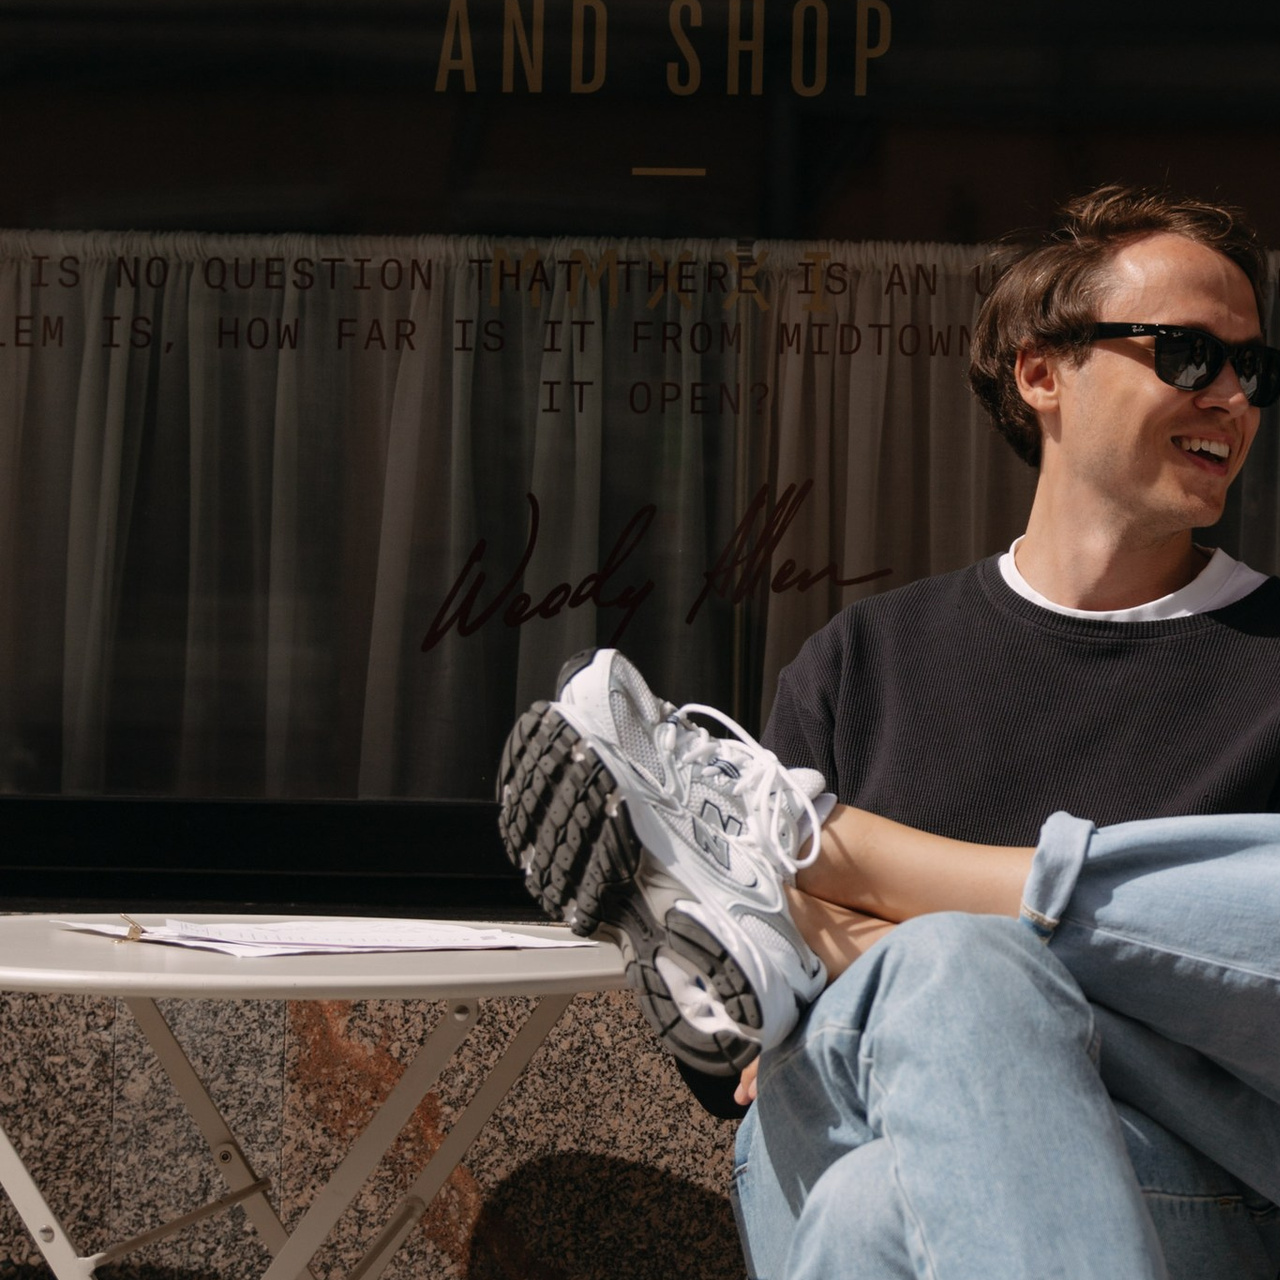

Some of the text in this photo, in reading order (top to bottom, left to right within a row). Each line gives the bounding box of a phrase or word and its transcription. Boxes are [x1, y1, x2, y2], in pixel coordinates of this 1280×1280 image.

[30, 255, 81, 288] IS
[116, 256, 170, 289] NO
[203, 257, 433, 294] QUESTION
[468, 259, 582, 292] THAT
[616, 260, 758, 294] THERE
[797, 262, 848, 295] IS
[884, 263, 937, 296] AN
[0, 315, 64, 348] EM
[101, 316, 174, 354] IS,
[216, 317, 300, 350] HOW
[337, 318, 417, 351] FAR
[453, 320, 506, 352] IS
[542, 321, 596, 353] IT
[632, 321, 743, 355] FROM
[541, 380, 771, 416] IT OPEN?
[685, 478, 893, 625] Allen
